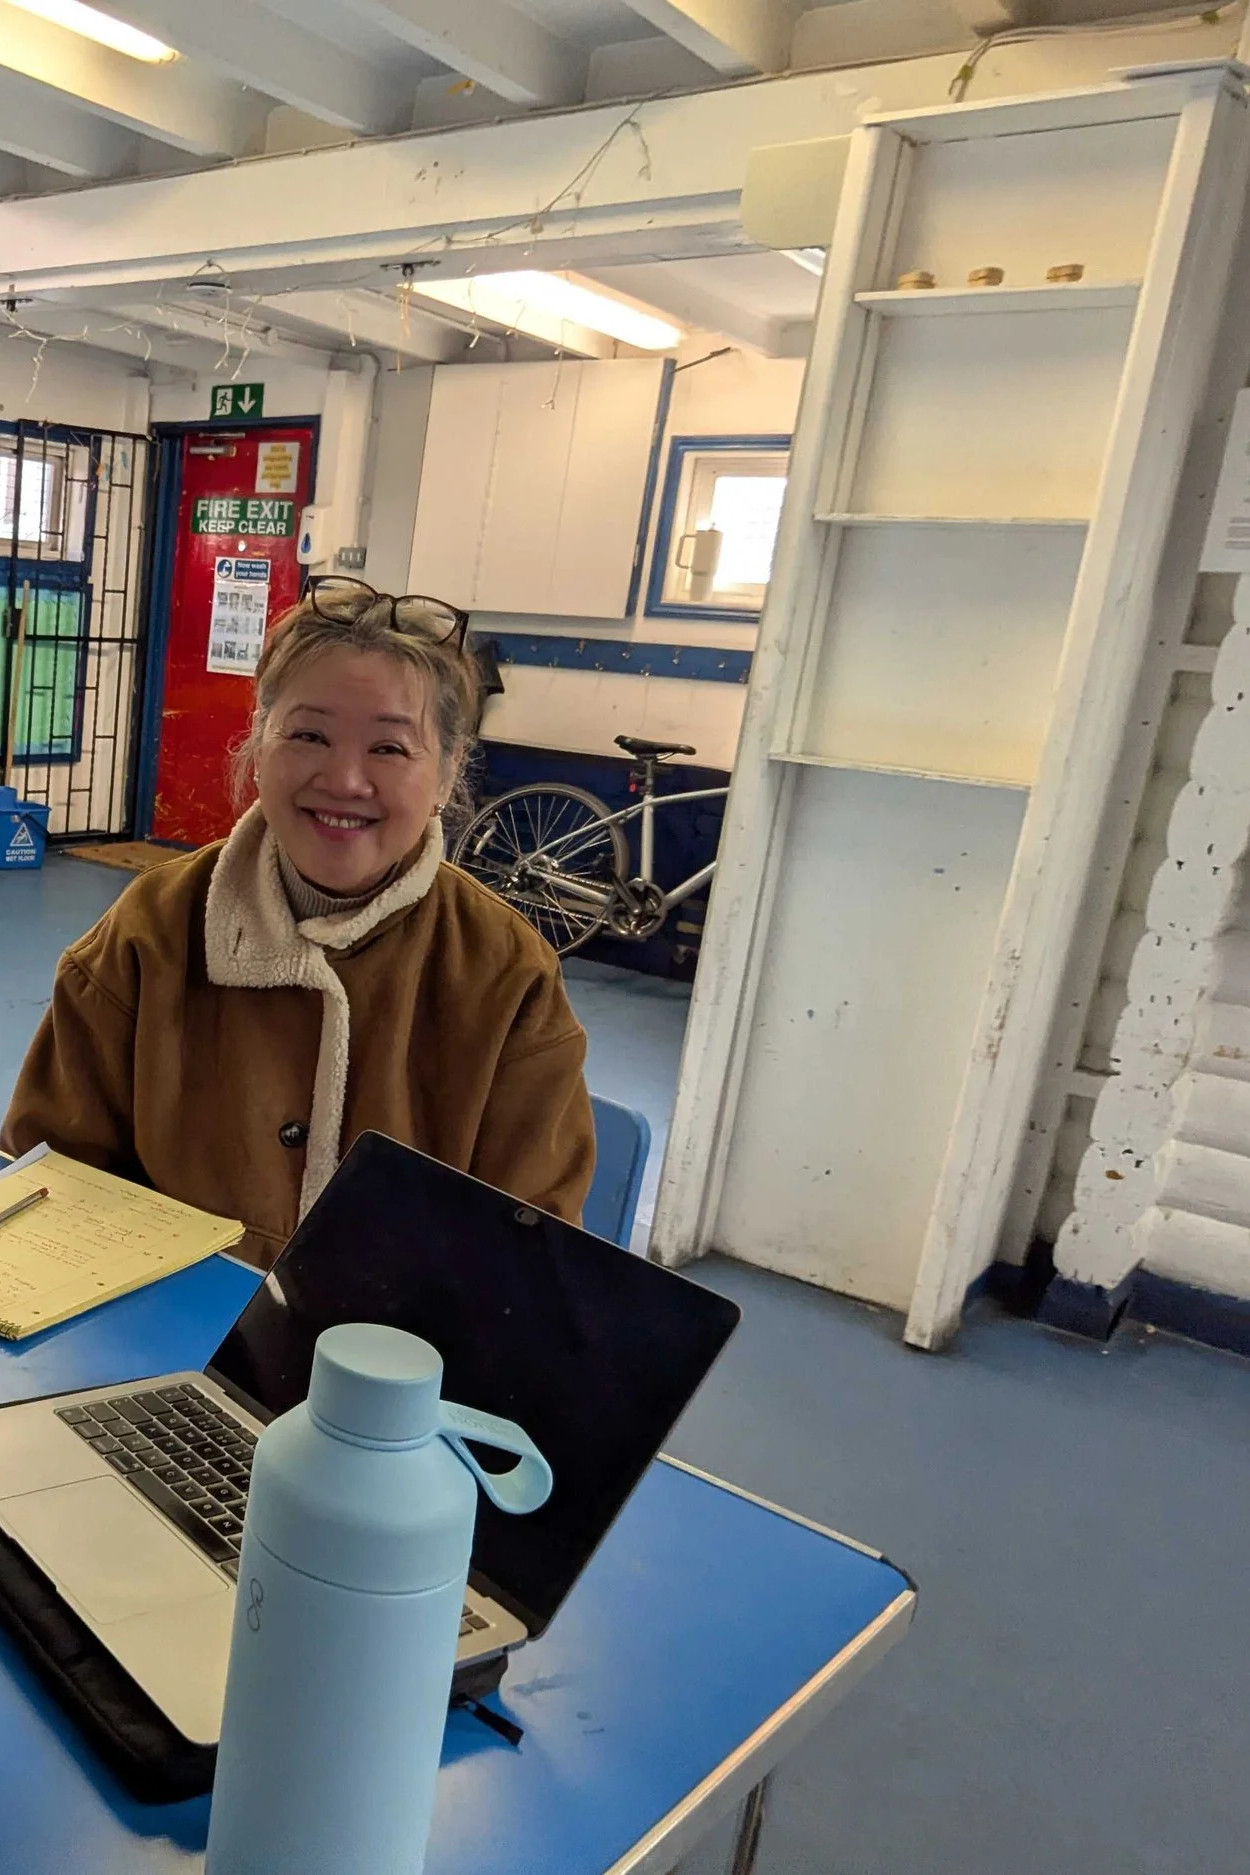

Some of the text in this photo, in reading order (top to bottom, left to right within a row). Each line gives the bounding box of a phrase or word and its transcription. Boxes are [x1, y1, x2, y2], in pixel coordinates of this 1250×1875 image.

[197, 499, 294, 520] FIRE EXIT
[199, 520, 286, 535] KEEP CLEAR
